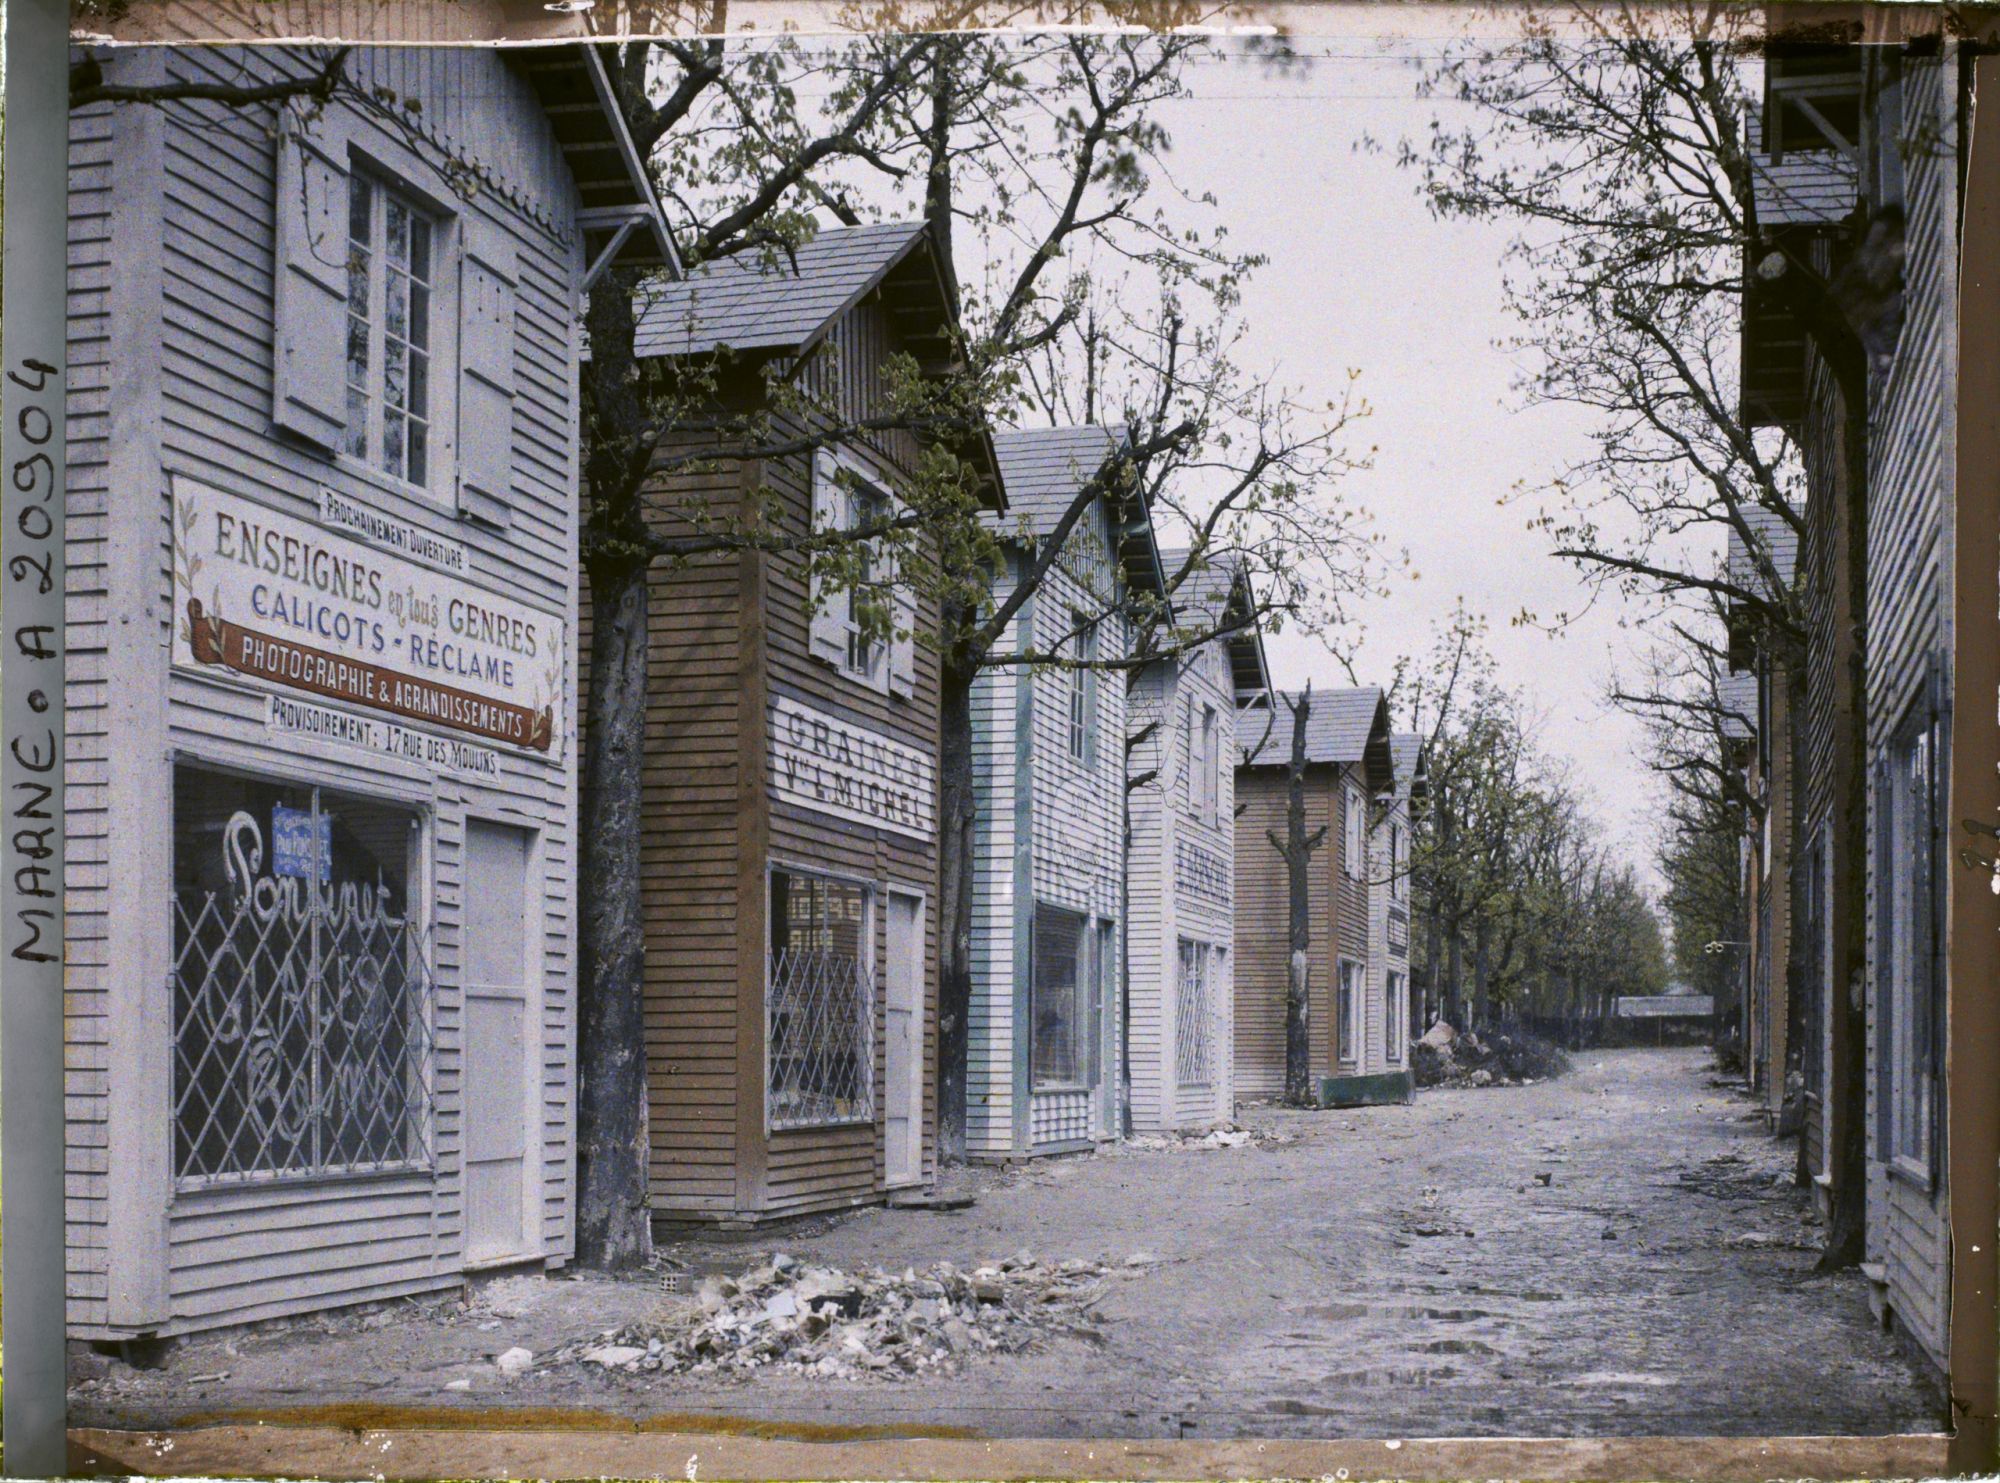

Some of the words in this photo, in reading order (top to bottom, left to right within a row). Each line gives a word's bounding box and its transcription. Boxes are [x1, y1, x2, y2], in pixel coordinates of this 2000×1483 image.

[326, 491, 407, 549] PROCHAINEMENT
[409, 528, 463, 571] OUVERTURE
[214, 511, 382, 610] ENSEIGNES
[407, 584, 440, 629] tous
[449, 598, 537, 658] GENRES
[252, 584, 385, 652] CALICOTS
[241, 635, 374, 700] PHOTOGRAPHIE
[379, 680, 391, 703] &
[395, 680, 523, 738] AGRANDISSEMENTS
[385, 725, 401, 754] 17
[403, 732, 423, 760] RUE
[427, 739, 446, 764] DES
[450, 741, 496, 774] MOULINS
[788, 711, 922, 786] GRAINES
[834, 770, 924, 828] MICHEL
